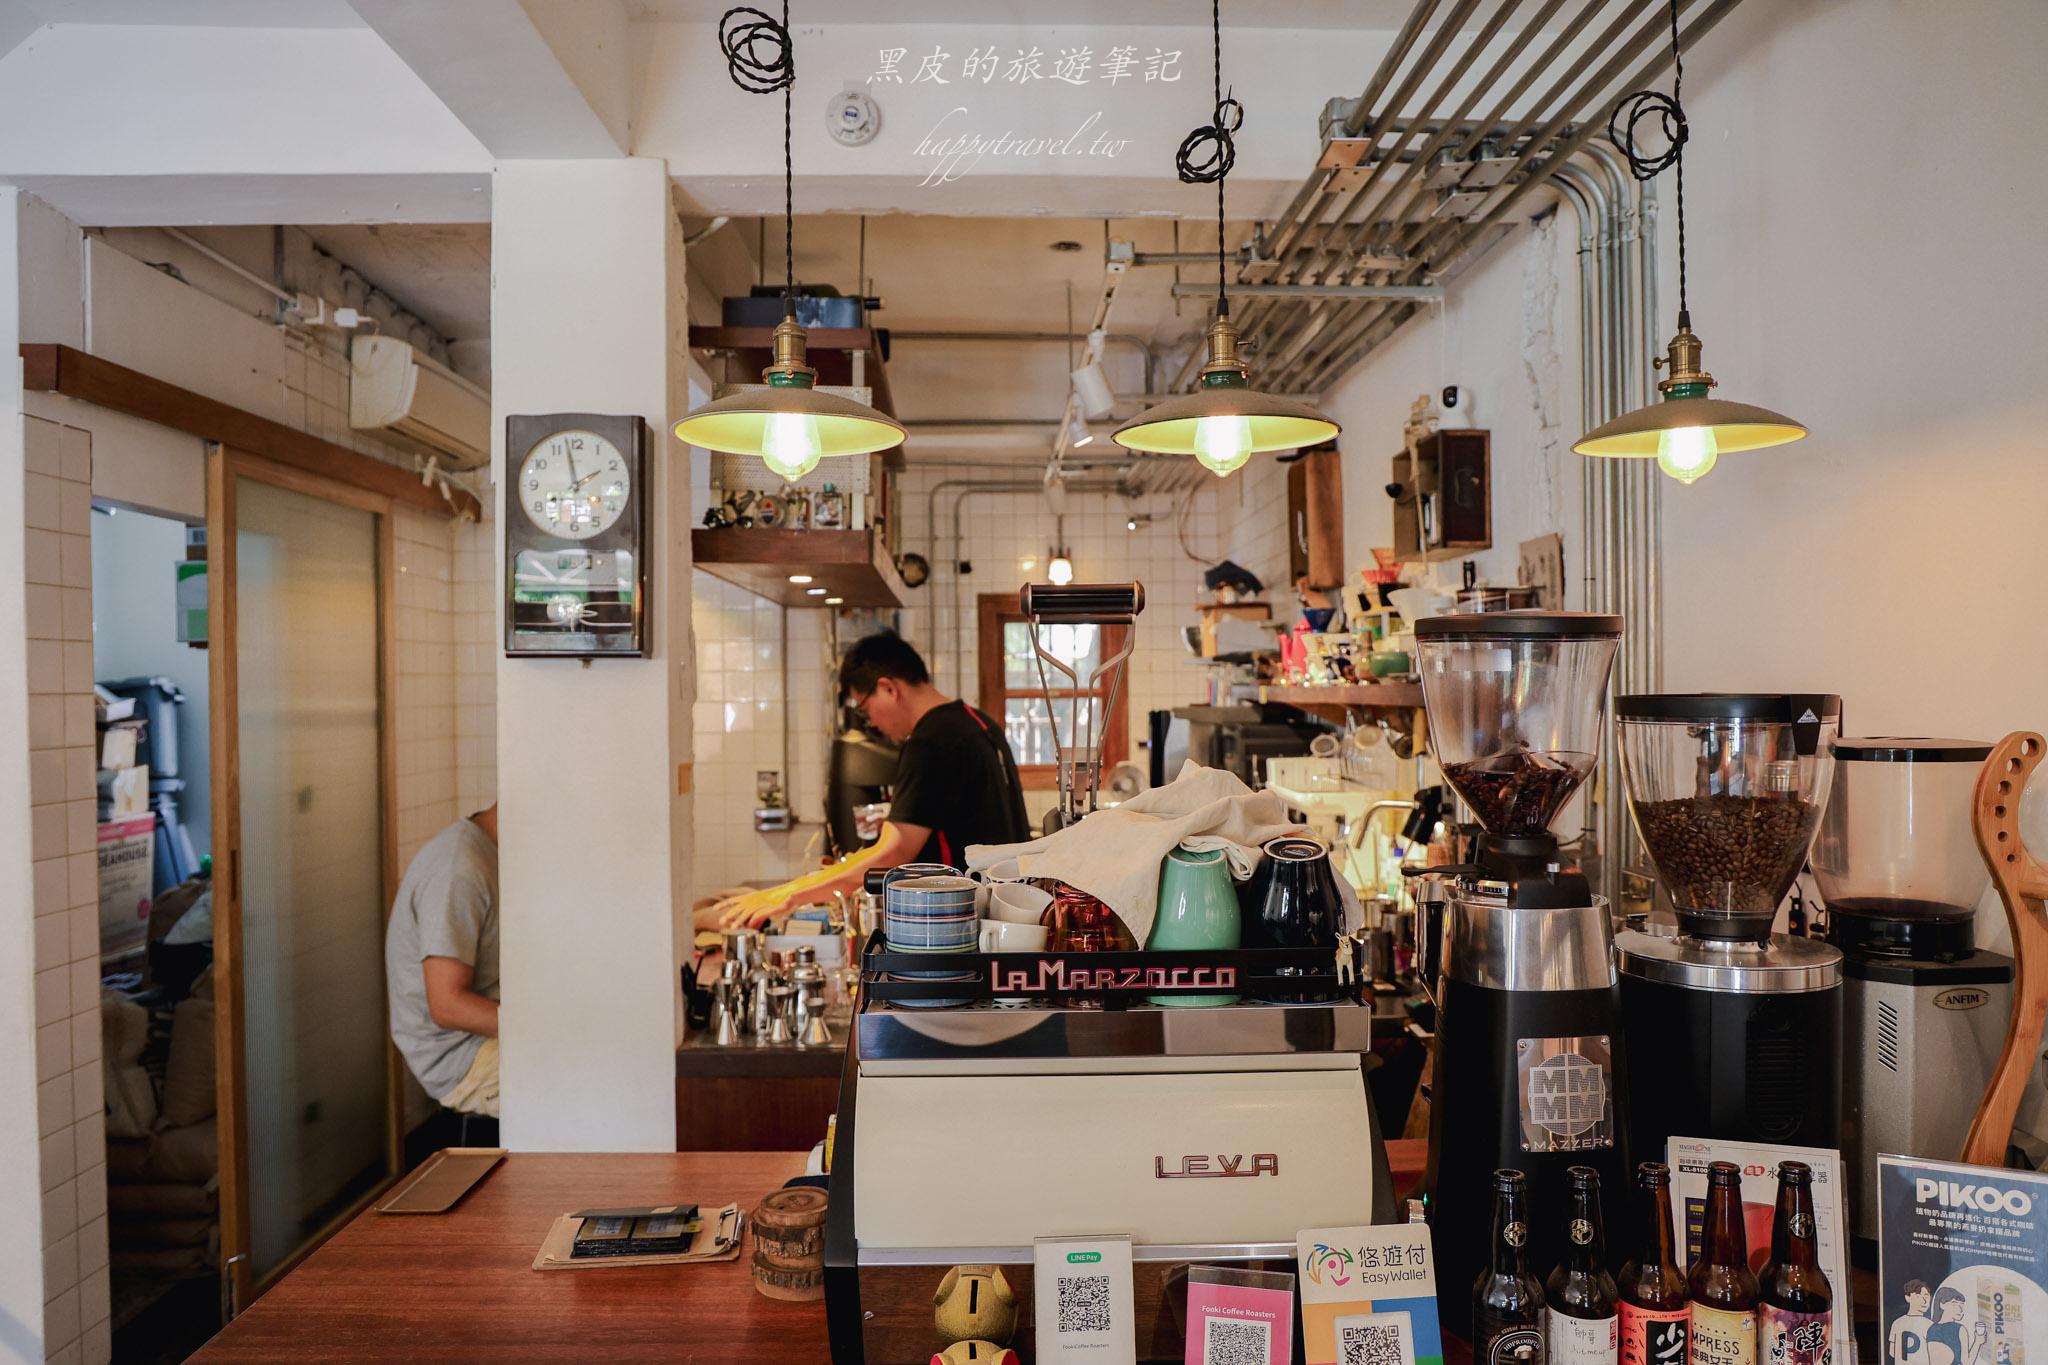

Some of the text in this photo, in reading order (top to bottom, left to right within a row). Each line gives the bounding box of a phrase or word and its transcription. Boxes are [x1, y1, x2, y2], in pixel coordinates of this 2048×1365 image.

[552, 445, 561, 455] 11
[571, 439, 584, 451] 12
[535, 459, 547, 470] 10
[608, 460, 618, 471] 2
[529, 480, 539, 491] 9
[534, 501, 543, 512] 8
[570, 521, 579, 532] 6
[591, 516, 601, 528] 5
[1945, 994, 1979, 1005] ANFIM
[1533, 1138, 1604, 1150] MAZZER
[1155, 1153, 1279, 1179] LEVA
[1915, 1178, 2032, 1216] PIKOO
[1070, 1254, 1098, 1262] LINE Pay
[1358, 1243, 1426, 1268] 悠遊付
[1362, 1269, 1427, 1284] EasyWallet
[1201, 1305, 1276, 1319] Fooki Coffee Roasters
[1993, 1292, 2004, 1334] PIKOO
[1691, 1330, 1740, 1355] MPRESS
